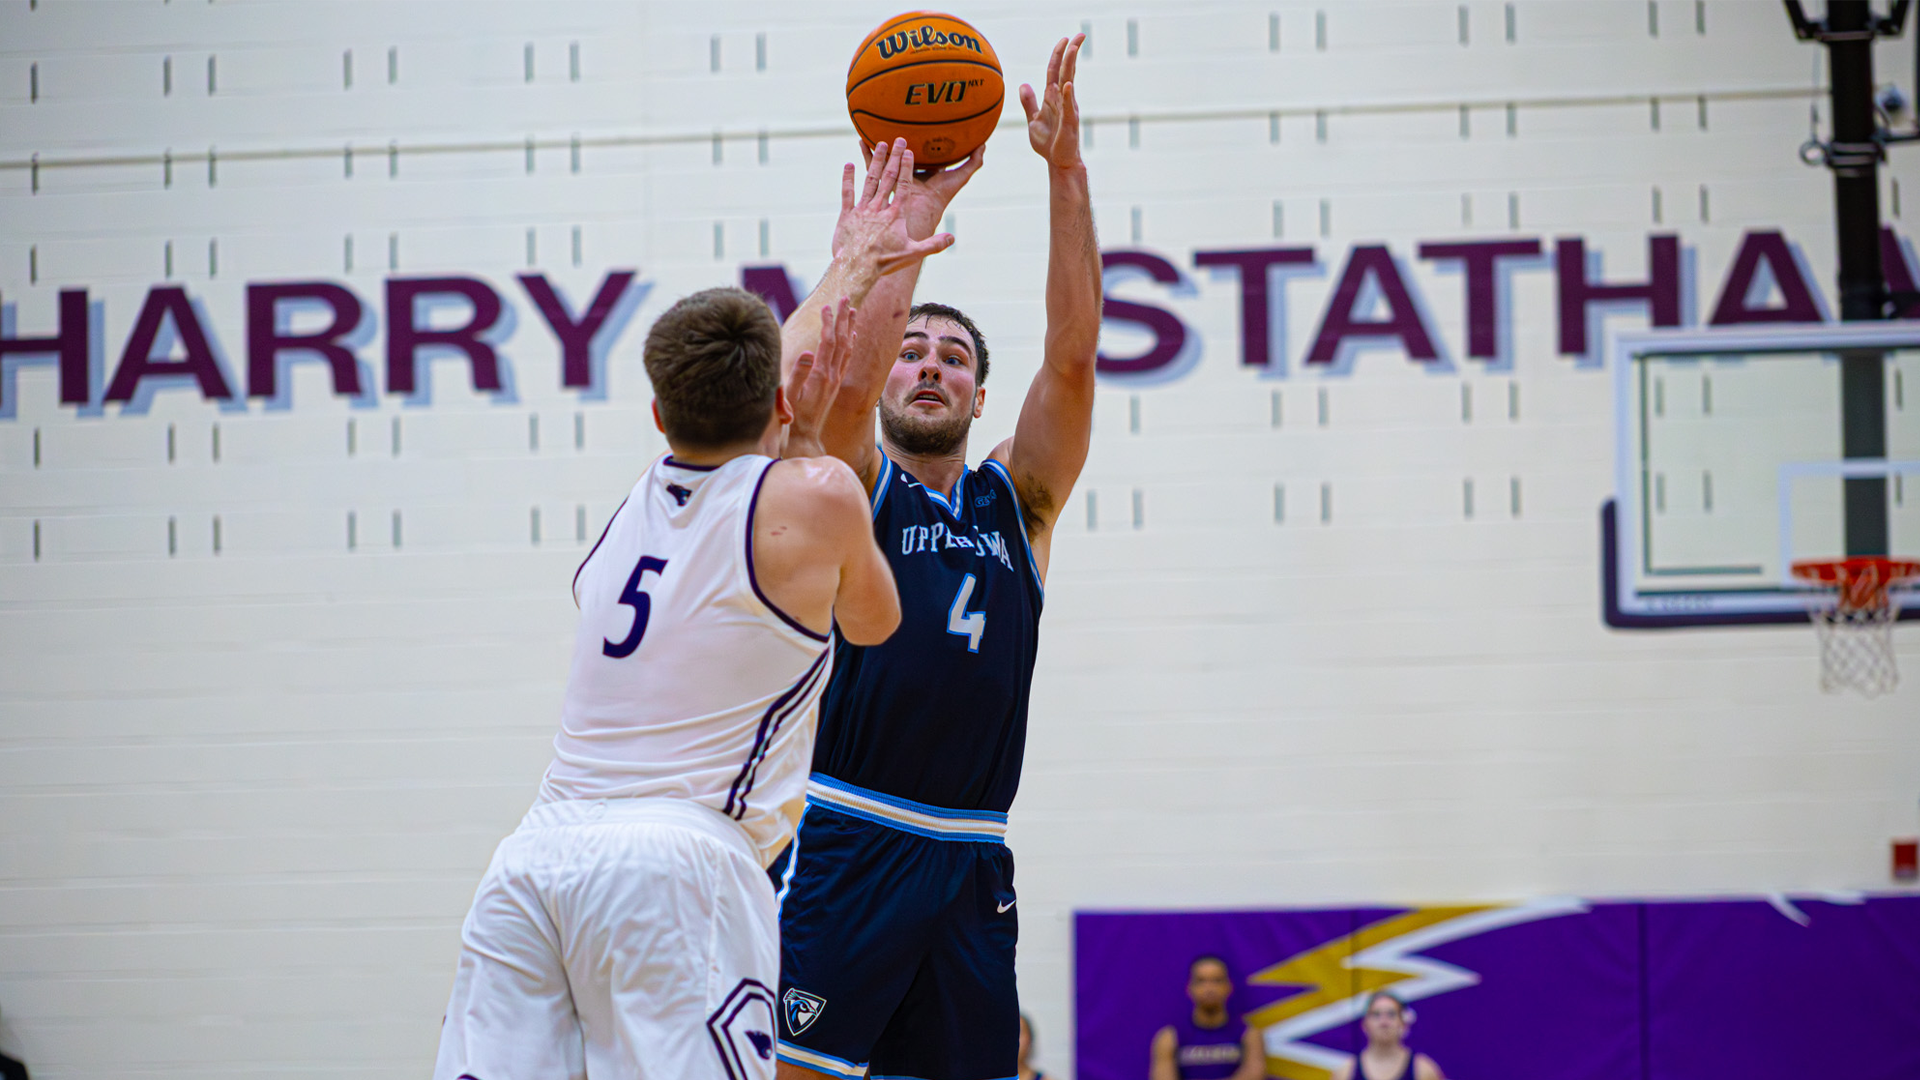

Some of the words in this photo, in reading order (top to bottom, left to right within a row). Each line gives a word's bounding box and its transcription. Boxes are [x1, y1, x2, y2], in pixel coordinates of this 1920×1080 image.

[876, 25, 982, 59] Wilson
[904, 80, 966, 105] EVO
[0, 270, 640, 405] HARRY
[1096, 225, 1920, 374] STATHA
[602, 555, 669, 659] 5
[947, 573, 987, 653] 4
